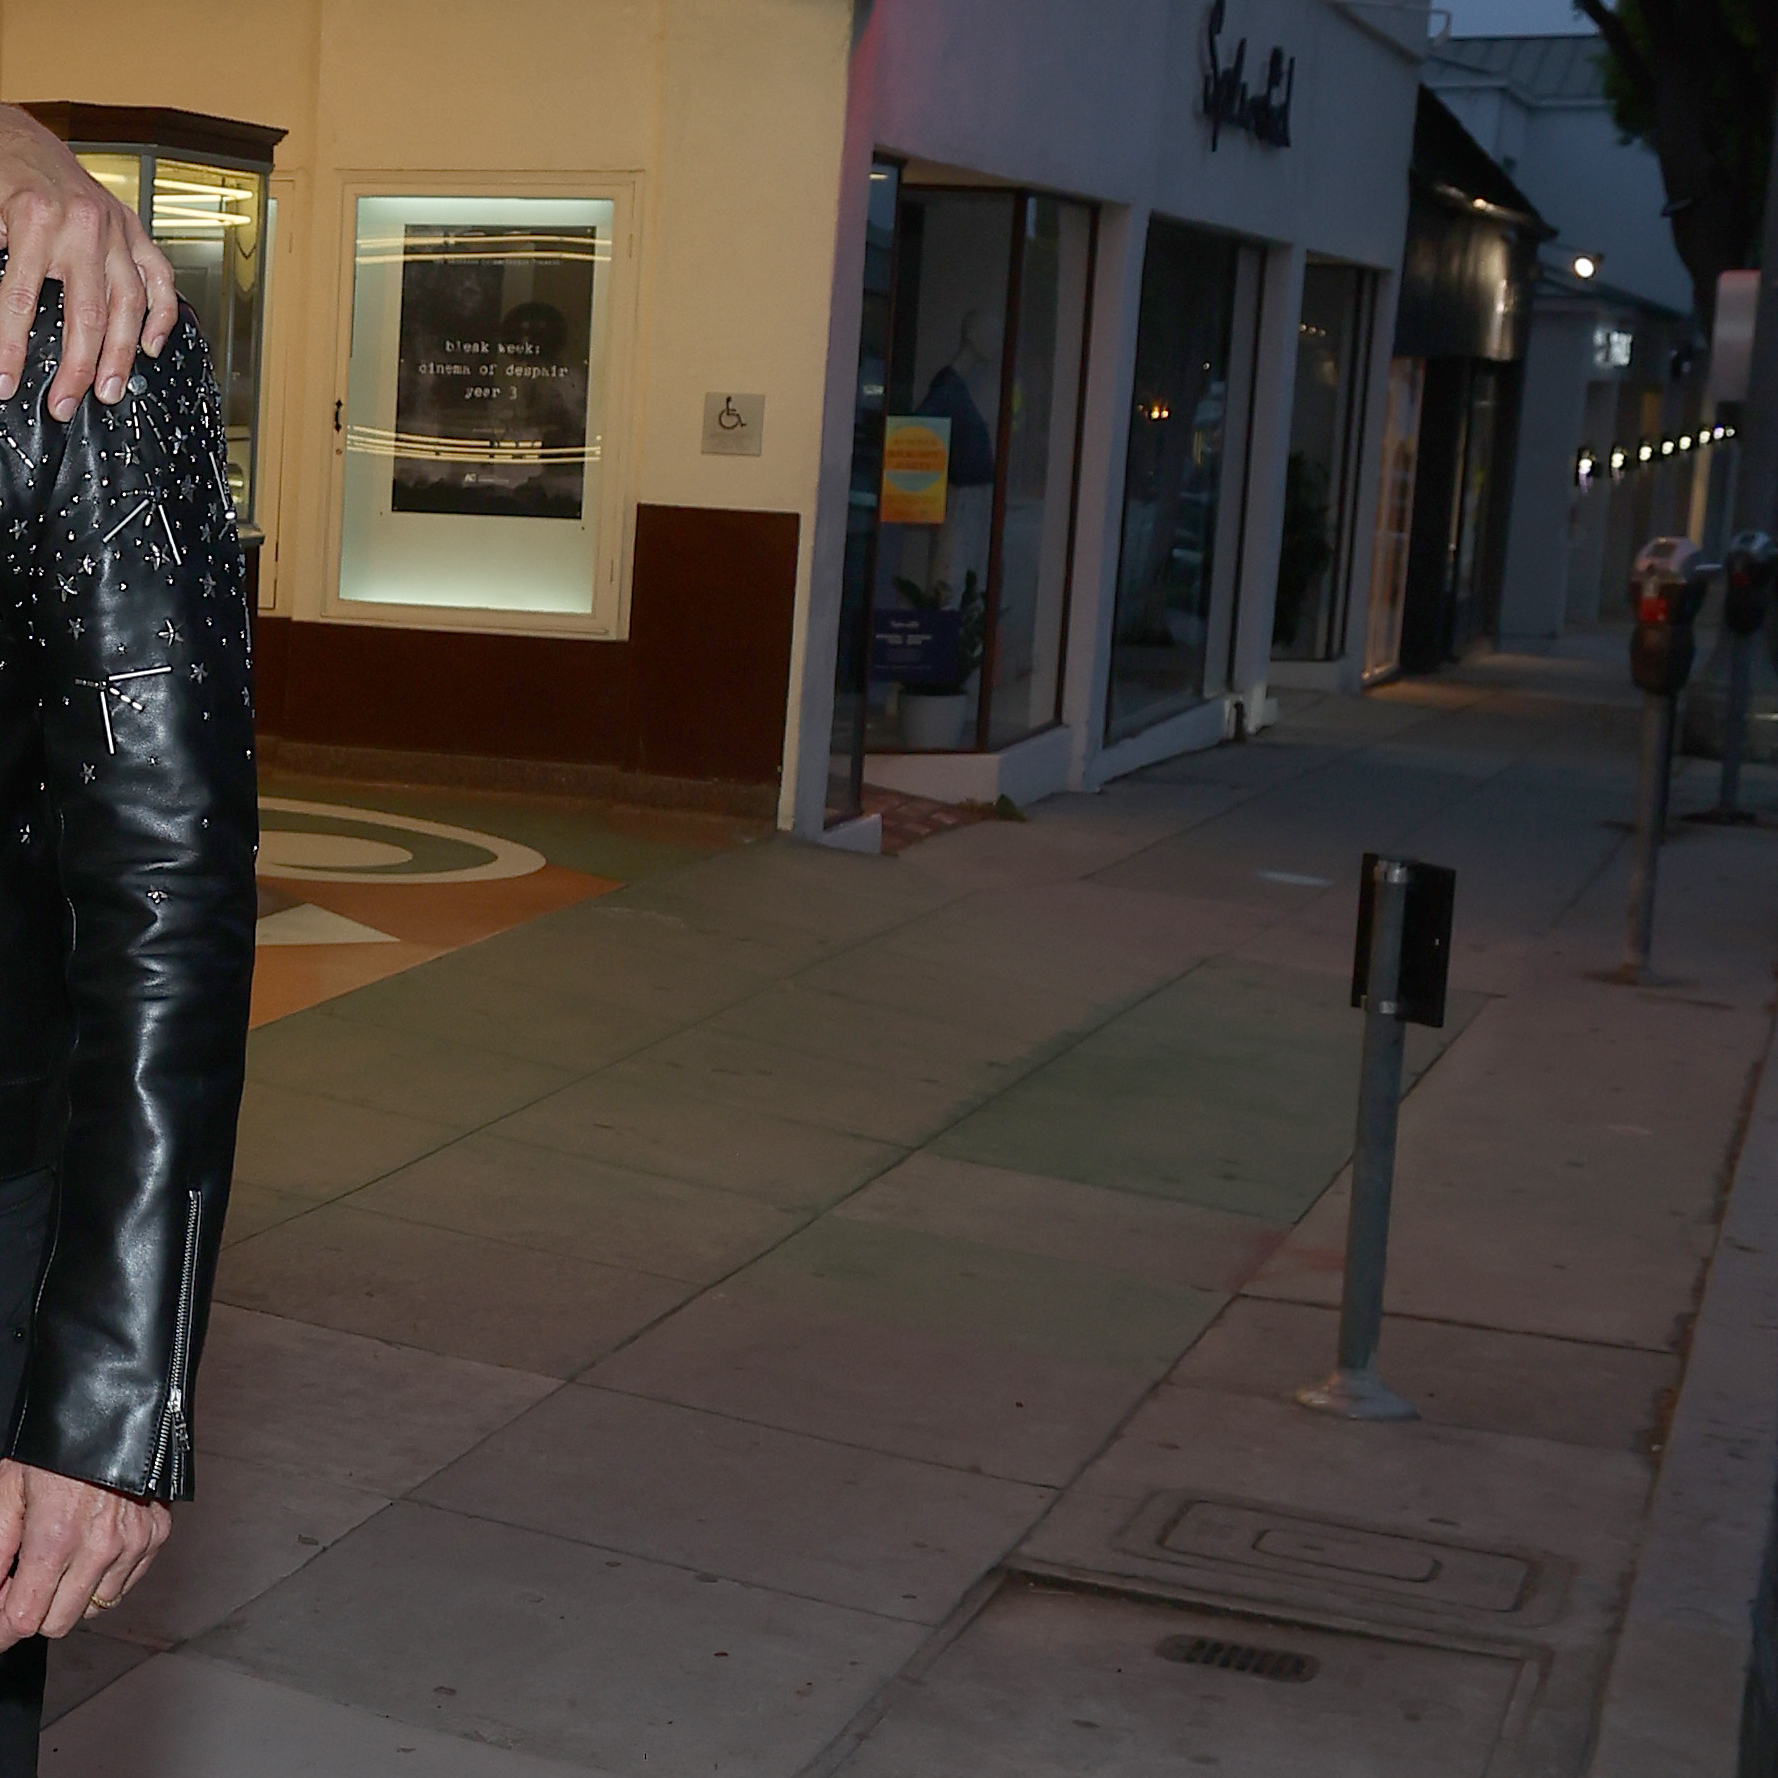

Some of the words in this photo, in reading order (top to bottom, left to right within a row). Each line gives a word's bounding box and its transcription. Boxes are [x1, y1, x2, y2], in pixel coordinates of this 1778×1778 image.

[444, 339, 490, 355] bleak
[497, 341, 541, 356] week:
[417, 361, 472, 376] cinema
[478, 363, 498, 377] of
[504, 364, 570, 380] despair
[464, 385, 503, 400] year
[508, 384, 519, 400] 3
